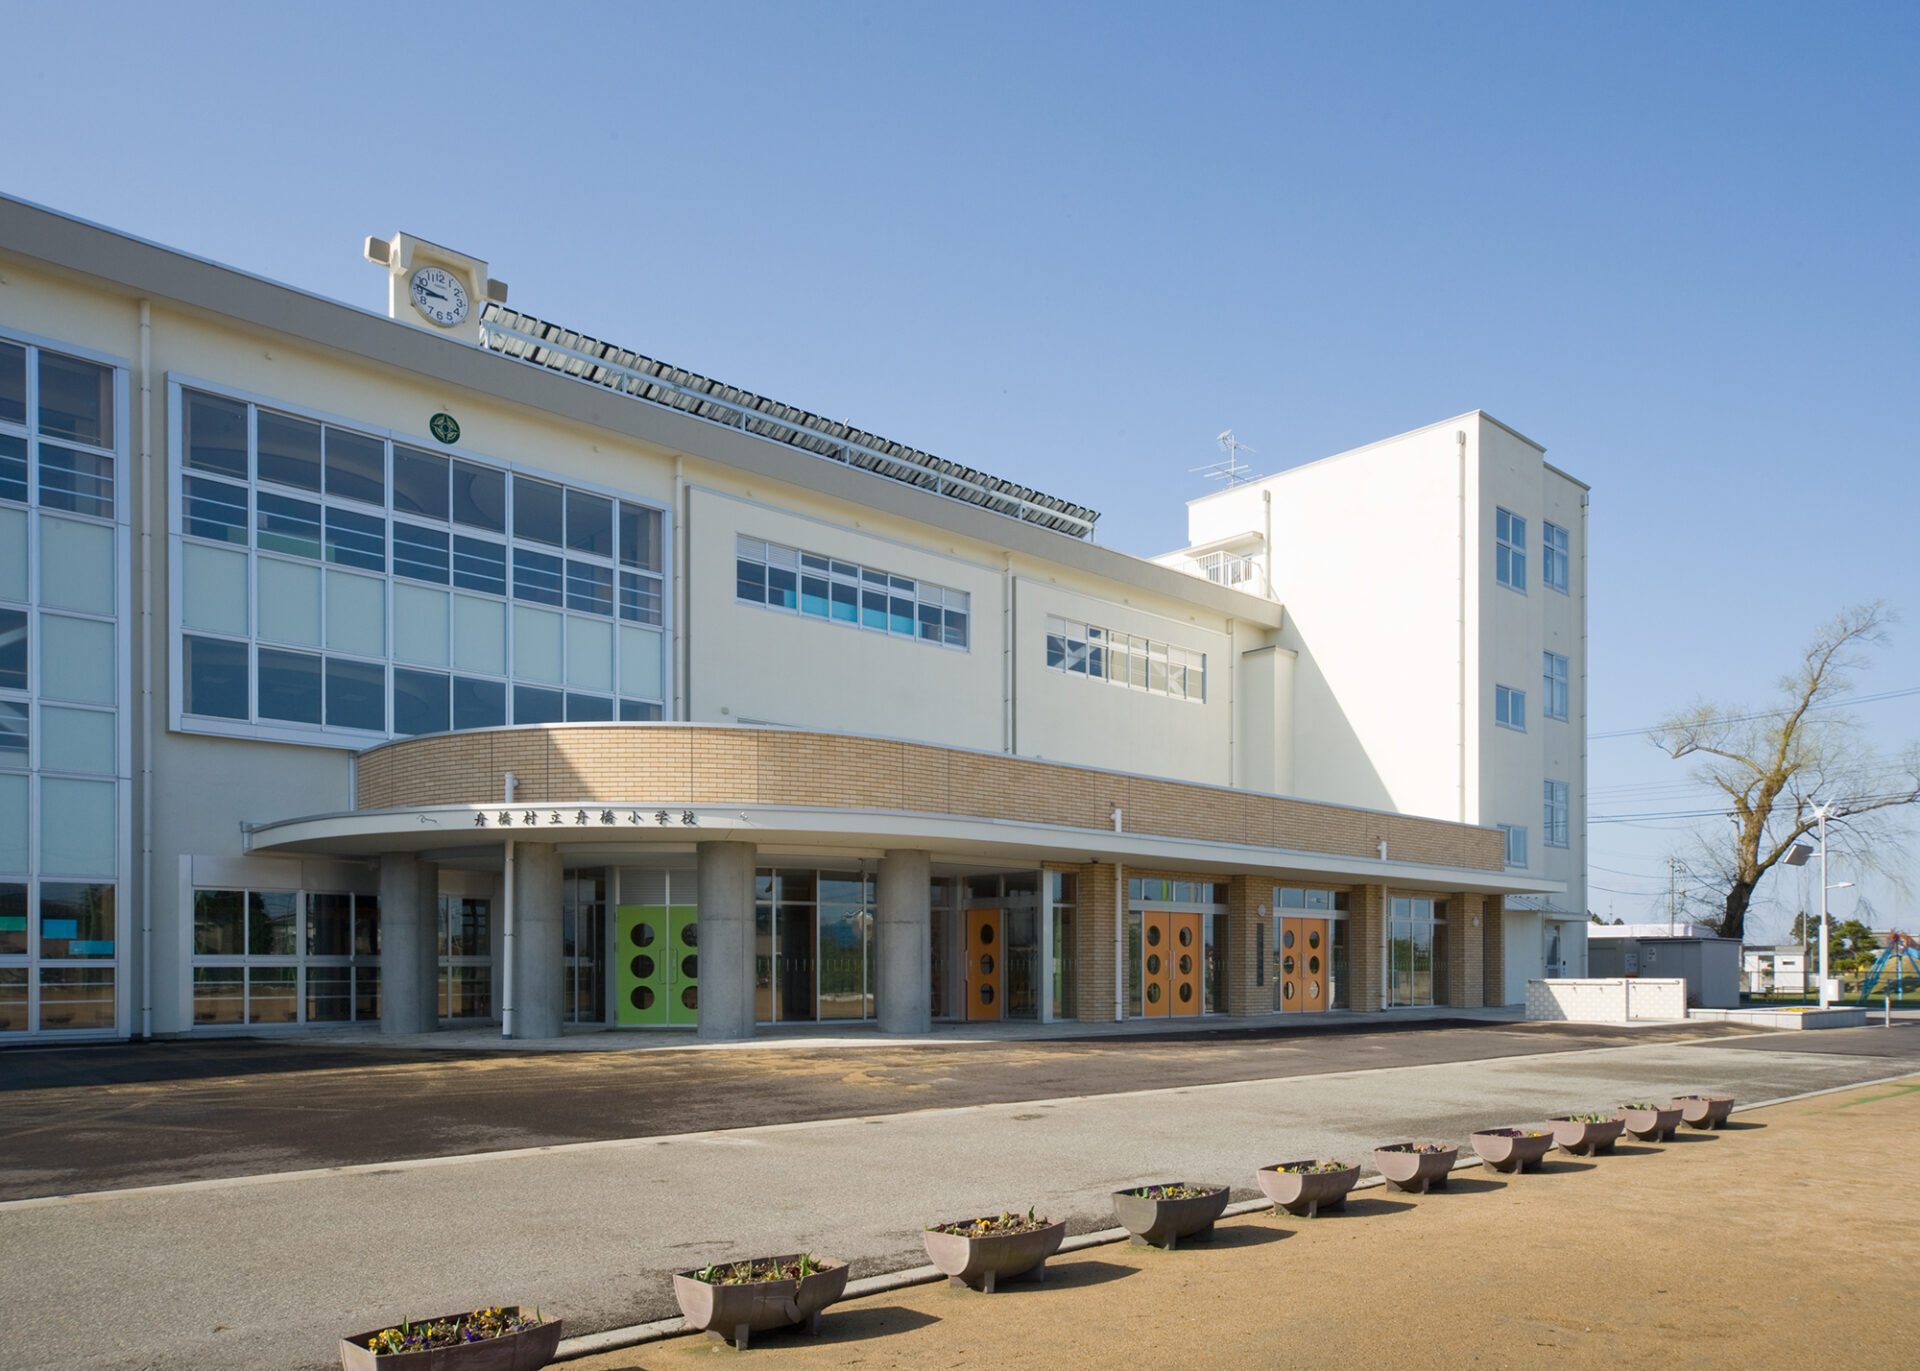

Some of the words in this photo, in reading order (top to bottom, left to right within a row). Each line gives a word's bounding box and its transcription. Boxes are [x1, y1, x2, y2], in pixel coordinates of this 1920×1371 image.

[436, 273, 445, 284] 12
[416, 285, 423, 295] 9
[454, 288, 460, 297] 2
[420, 296, 426, 305] 8
[456, 299, 463, 308] 3
[428, 305, 434, 314] 7
[453, 308, 460, 316] 4
[436, 311, 443, 320] 6
[446, 312, 453, 321] 5
[474, 809, 697, 827] 舟橋村立舟橋小学校
